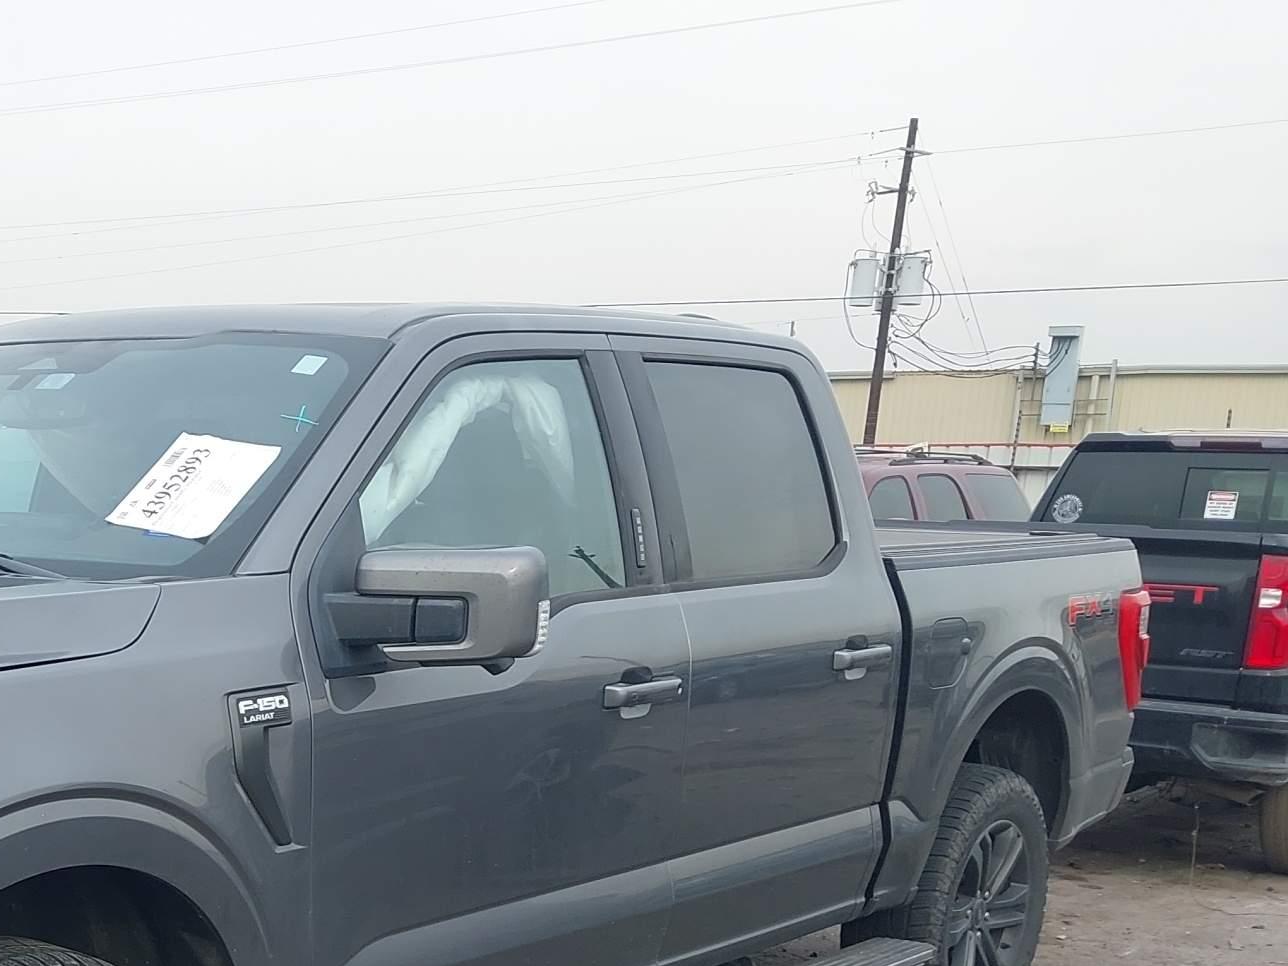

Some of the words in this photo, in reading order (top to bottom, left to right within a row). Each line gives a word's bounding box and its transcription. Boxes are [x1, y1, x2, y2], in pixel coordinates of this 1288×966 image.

[142, 448, 211, 519] 43952893
[1069, 593, 1114, 626] FX4
[238, 695, 289, 714] F-150
[244, 712, 275, 723] LARIAT
